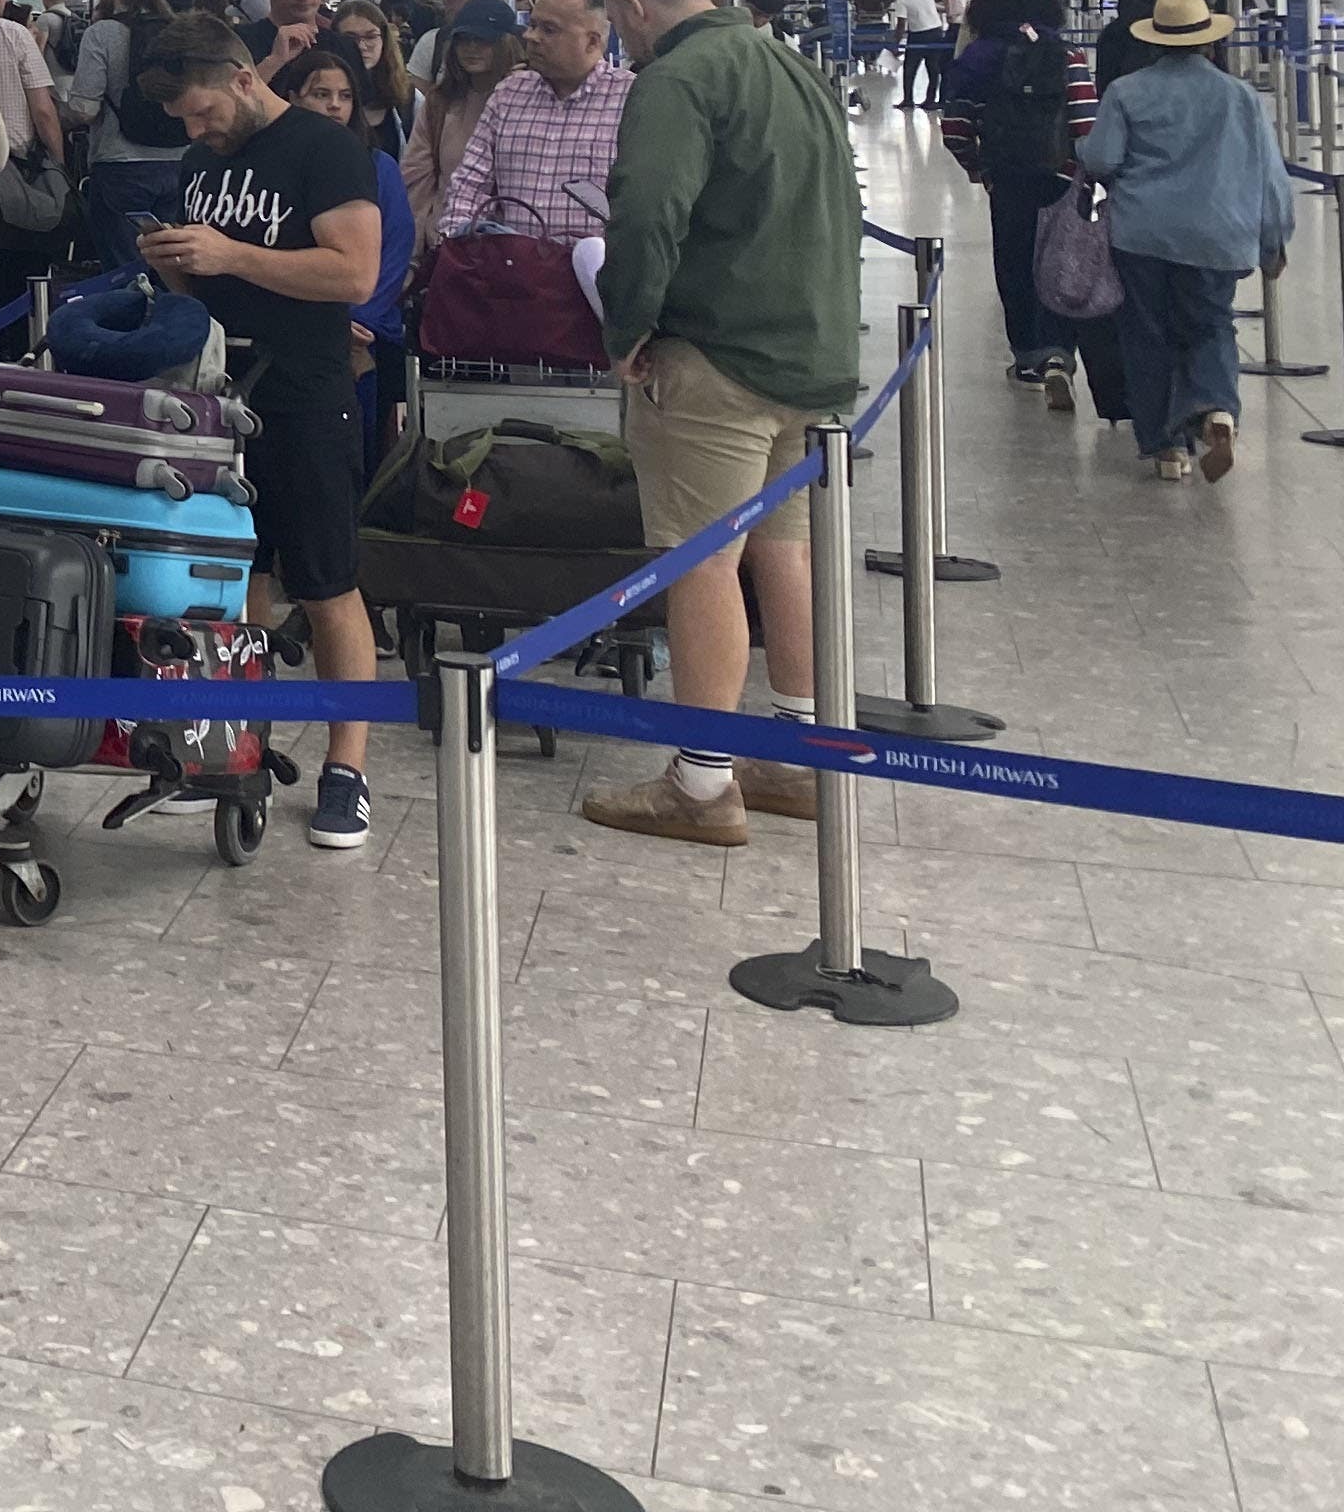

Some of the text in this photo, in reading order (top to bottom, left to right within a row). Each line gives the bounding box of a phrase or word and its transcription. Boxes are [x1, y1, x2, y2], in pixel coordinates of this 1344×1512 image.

[184, 168, 293, 246] Hubby
[885, 749, 1059, 789] BRITISH AIRWAYS
